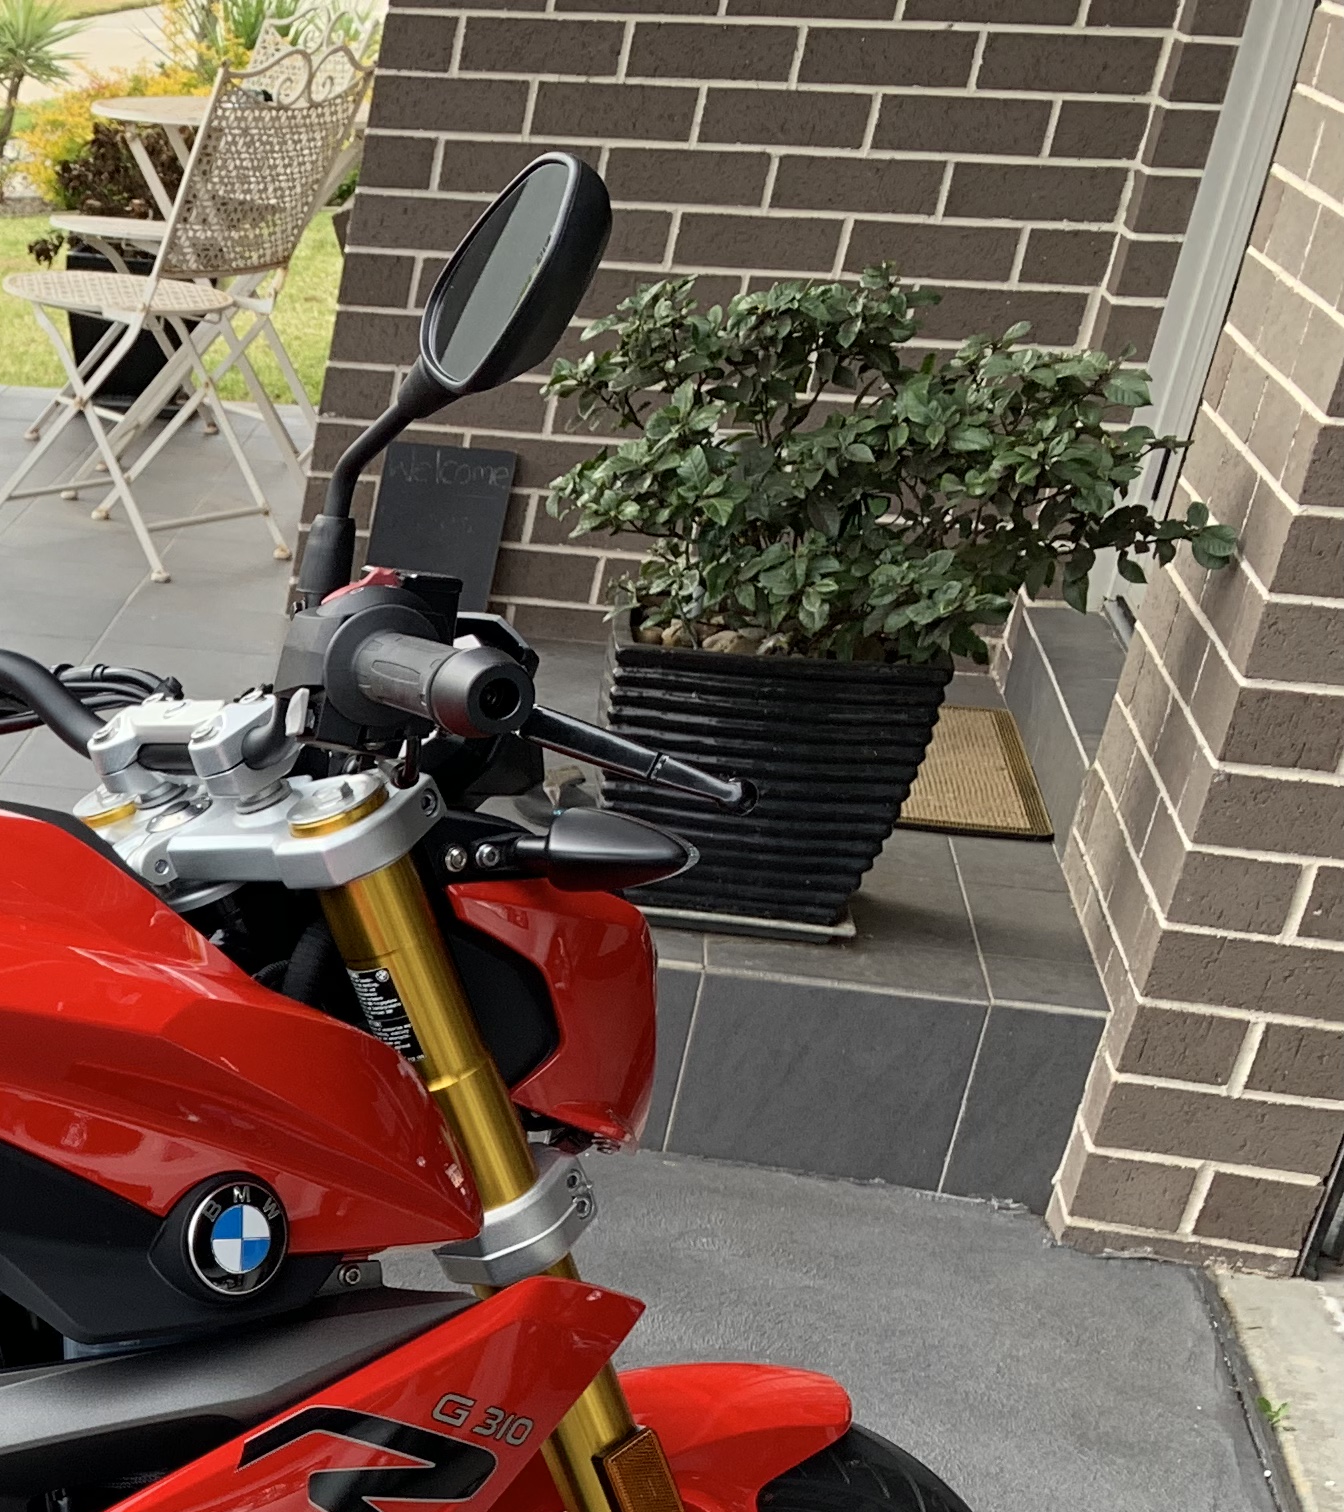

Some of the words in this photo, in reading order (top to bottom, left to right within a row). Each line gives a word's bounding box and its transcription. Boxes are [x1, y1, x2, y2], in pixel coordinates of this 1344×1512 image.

[201, 1185, 281, 1222] BMW
[432, 1392, 476, 1427] G
[472, 1406, 534, 1446] 310
